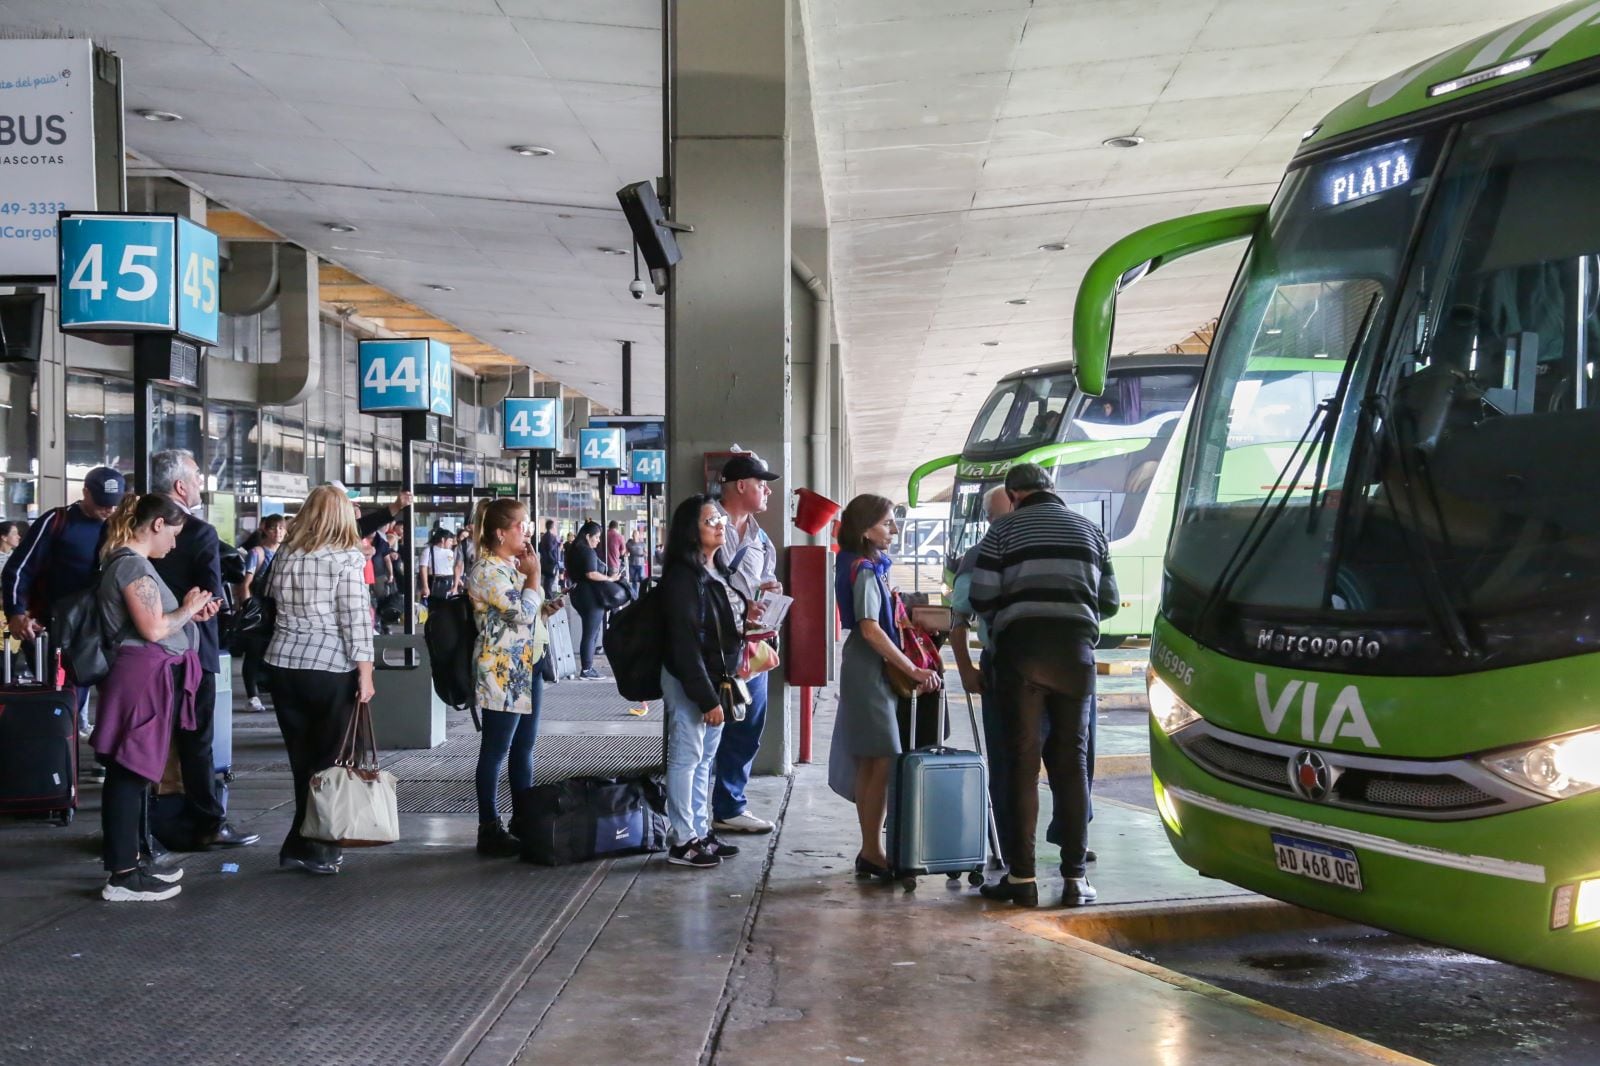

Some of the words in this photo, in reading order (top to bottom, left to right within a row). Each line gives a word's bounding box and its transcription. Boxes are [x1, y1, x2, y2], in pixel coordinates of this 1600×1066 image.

[0, 115, 67, 145] BUS
[0, 155, 64, 165] ASCOTAS
[1332, 154, 1410, 206] PLATA
[68, 243, 158, 302] 45
[183, 252, 216, 314] 45
[364, 356, 421, 394] 44
[509, 410, 551, 437] 43
[583, 438, 618, 459] 42
[636, 457, 662, 475] 41
[959, 463, 985, 476] Via
[1258, 629, 1381, 659] Marcopolo
[1255, 672, 1382, 748] VIA
[1279, 847, 1298, 871] AD
[1302, 852, 1330, 879] 468
